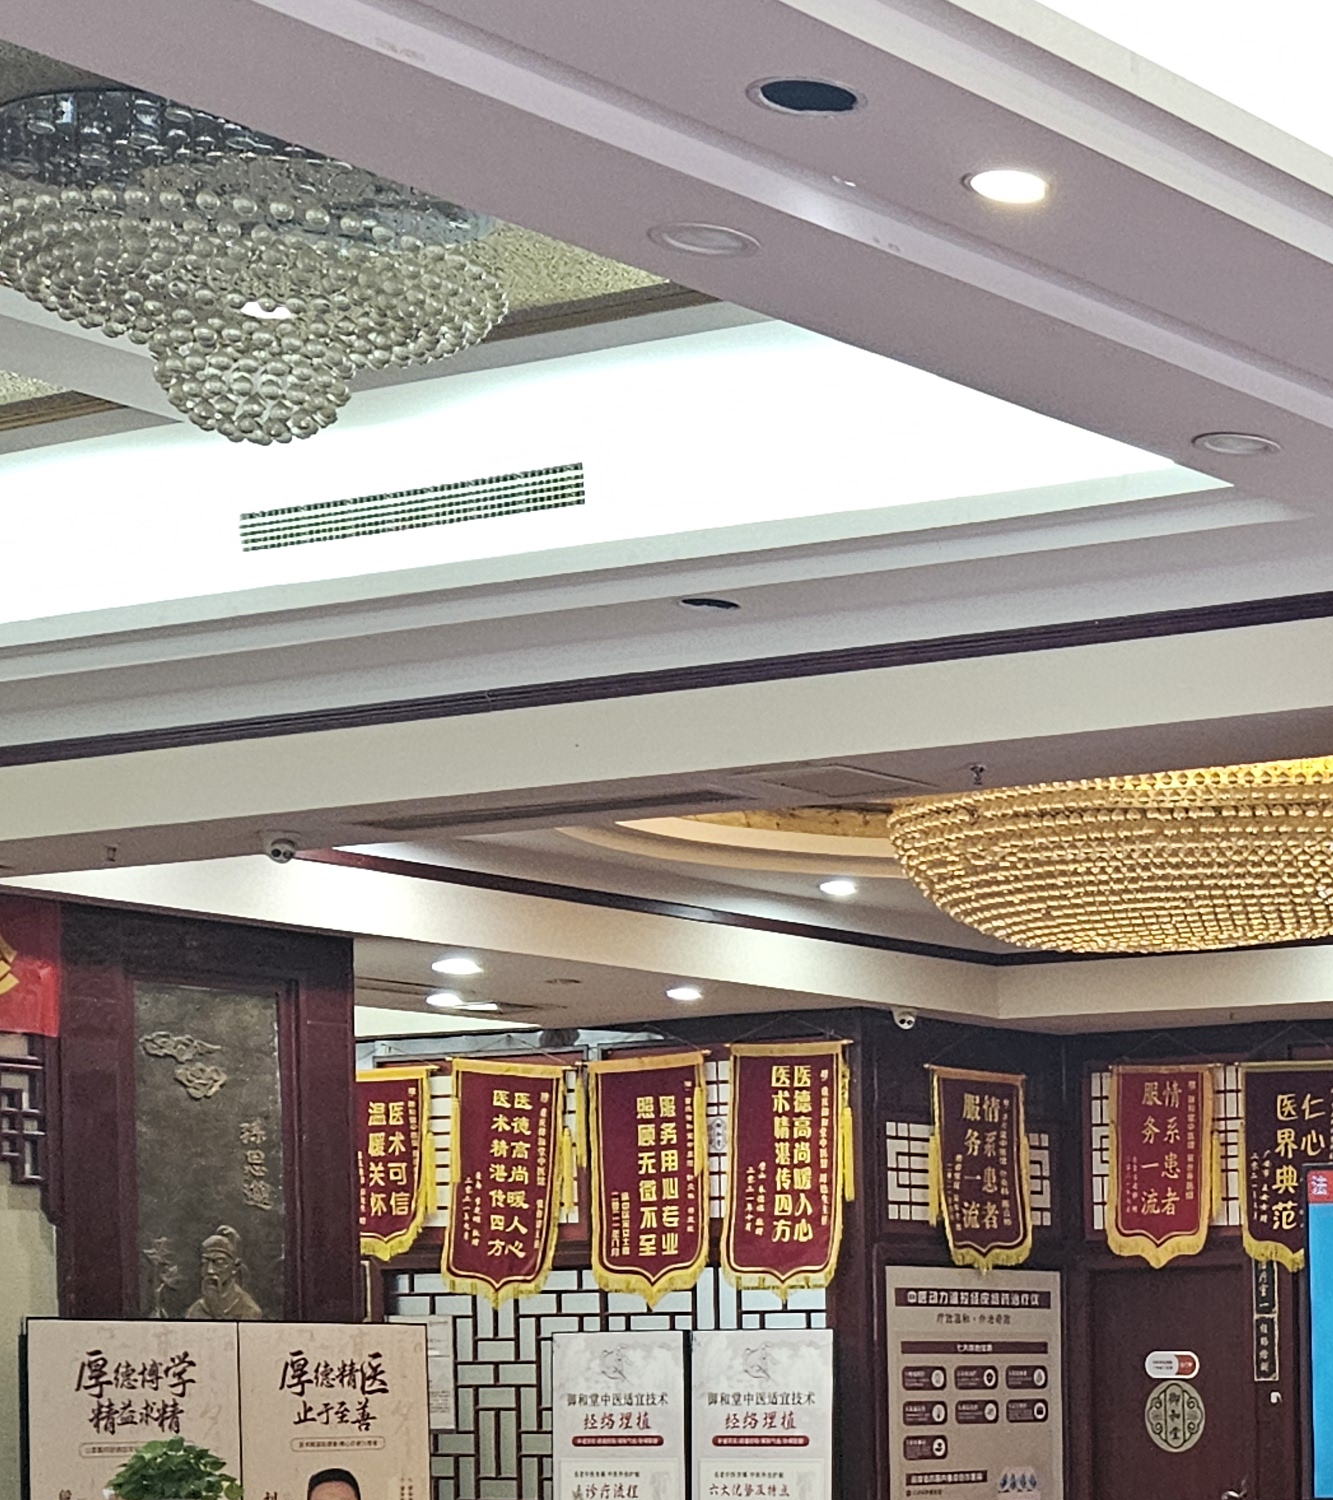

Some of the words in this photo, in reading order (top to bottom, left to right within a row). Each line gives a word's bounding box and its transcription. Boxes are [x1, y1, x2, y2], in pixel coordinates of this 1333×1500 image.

[367, 1101, 388, 1217] 温暖关怀
[386, 1101, 411, 1217] 医术可信
[487, 1089, 512, 1257] 医术精湛传四方
[506, 1091, 533, 1259] 医德高尚暖人心
[636, 1095, 658, 1257] 照顾无微不至
[659, 1094, 680, 1256] 服务用心专业
[771, 1064, 792, 1244] 医术精湛传四方
[792, 1064, 814, 1243] 医德高尚暖人心
[962, 1092, 982, 1230] 服务一流
[982, 1094, 1000, 1230] 情系患者
[1141, 1081, 1162, 1217] 服务一流
[1161, 1080, 1183, 1217] 情系患者
[1271, 1094, 1299, 1231] 医界典范
[1301, 1093, 1326, 1156] 仁心
[75, 1349, 197, 1398] 厚德博学
[87, 1398, 185, 1435] 精益求精
[279, 1350, 390, 1397] 厚德精医
[292, 1398, 378, 1432] 止于至善
[567, 1392, 669, 1407] 御和堂中医适宜技术
[707, 1391, 816, 1407] 御和堂中医适宜技术
[708, 1482, 791, 1498] 六大优势及特点
